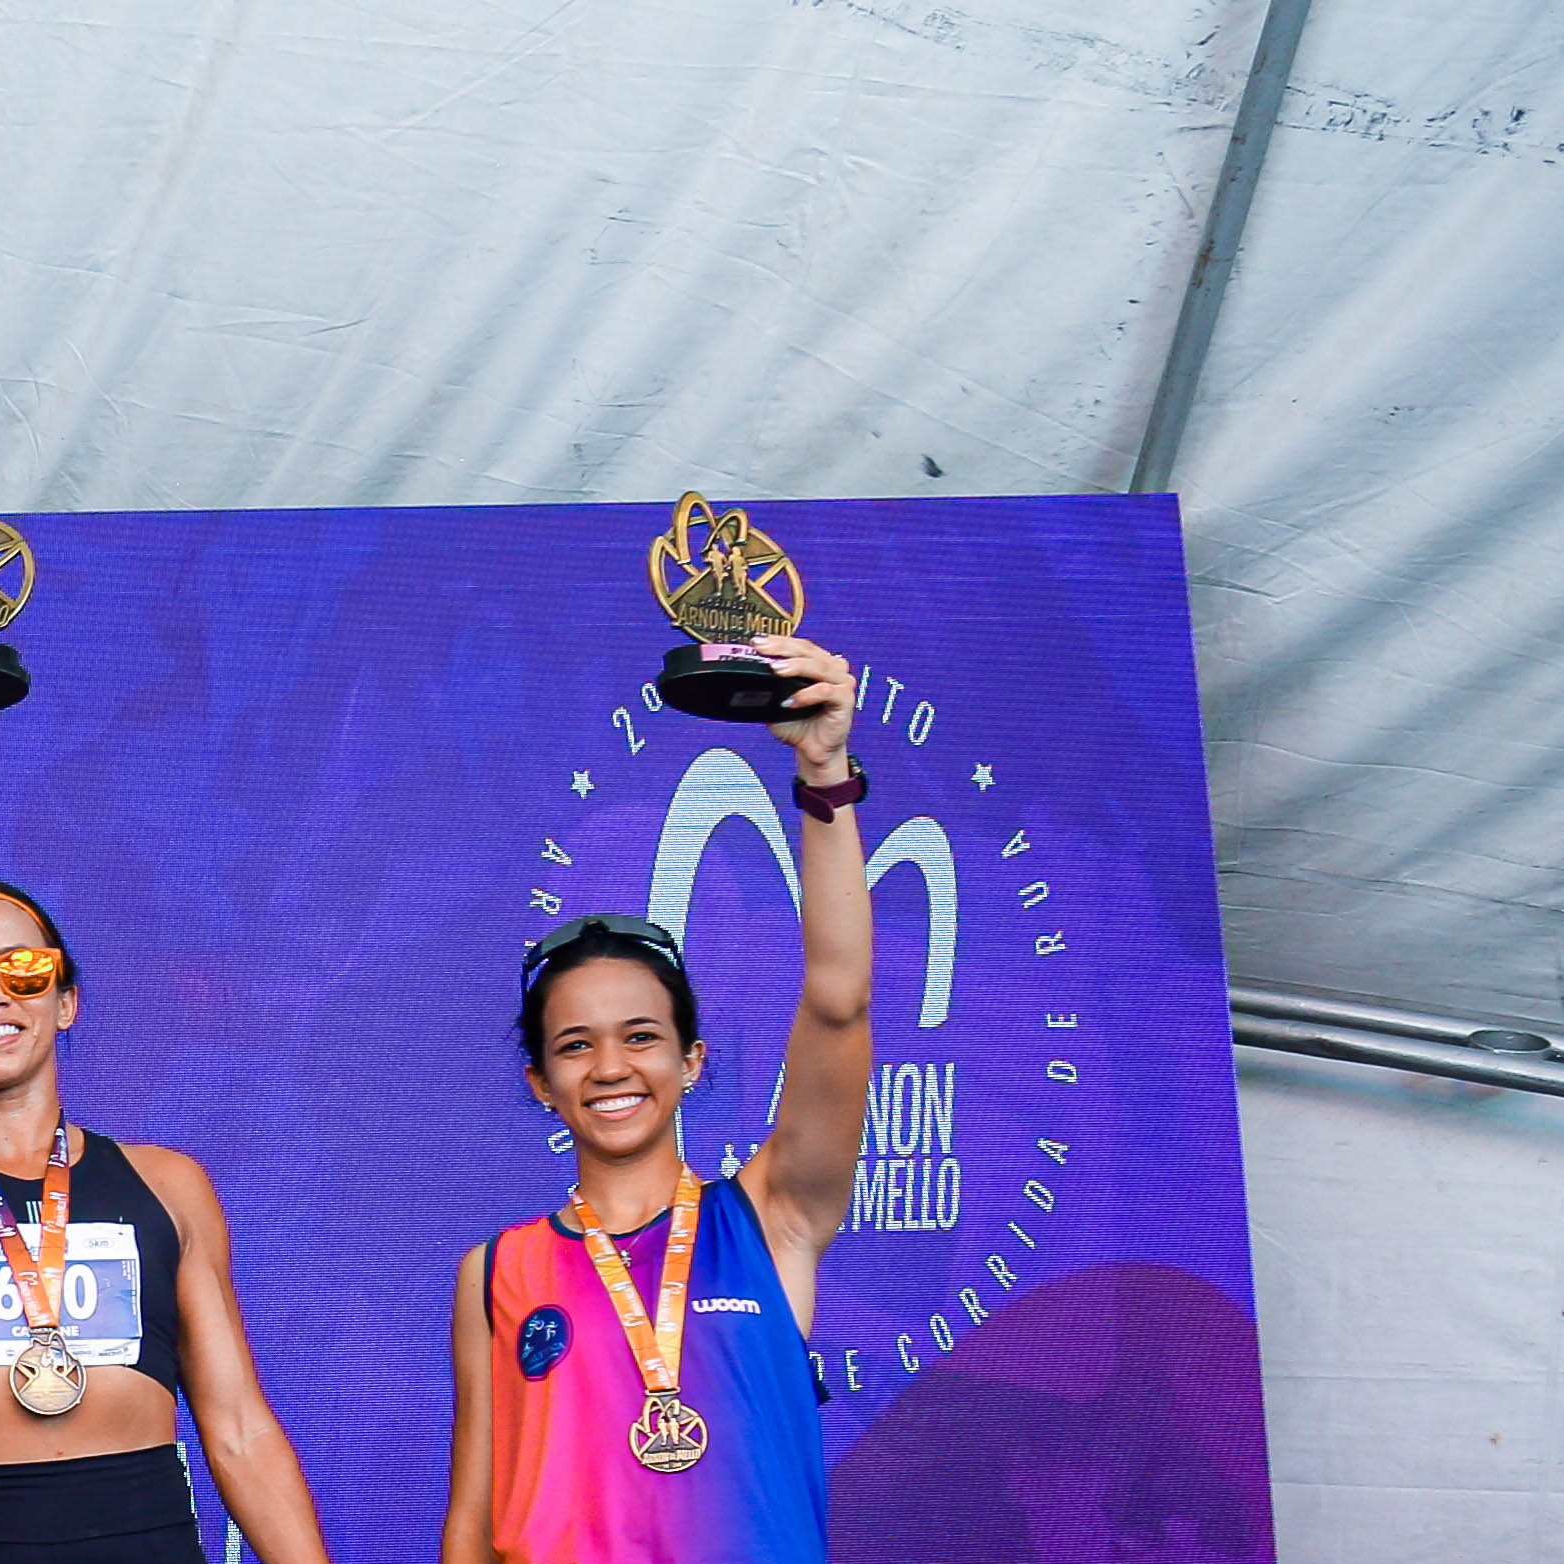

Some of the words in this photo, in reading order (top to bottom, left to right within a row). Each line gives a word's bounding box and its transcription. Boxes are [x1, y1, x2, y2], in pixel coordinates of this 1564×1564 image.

[677, 602, 730, 631] ARNON
[730, 613, 744, 630] DE
[745, 611, 793, 637] MELLO
[1001, 829, 1068, 957] RUA
[1044, 1011, 1079, 1084] DE
[852, 1158, 961, 1232] MELLO
[896, 1137, 1071, 1373] CORRIDA
